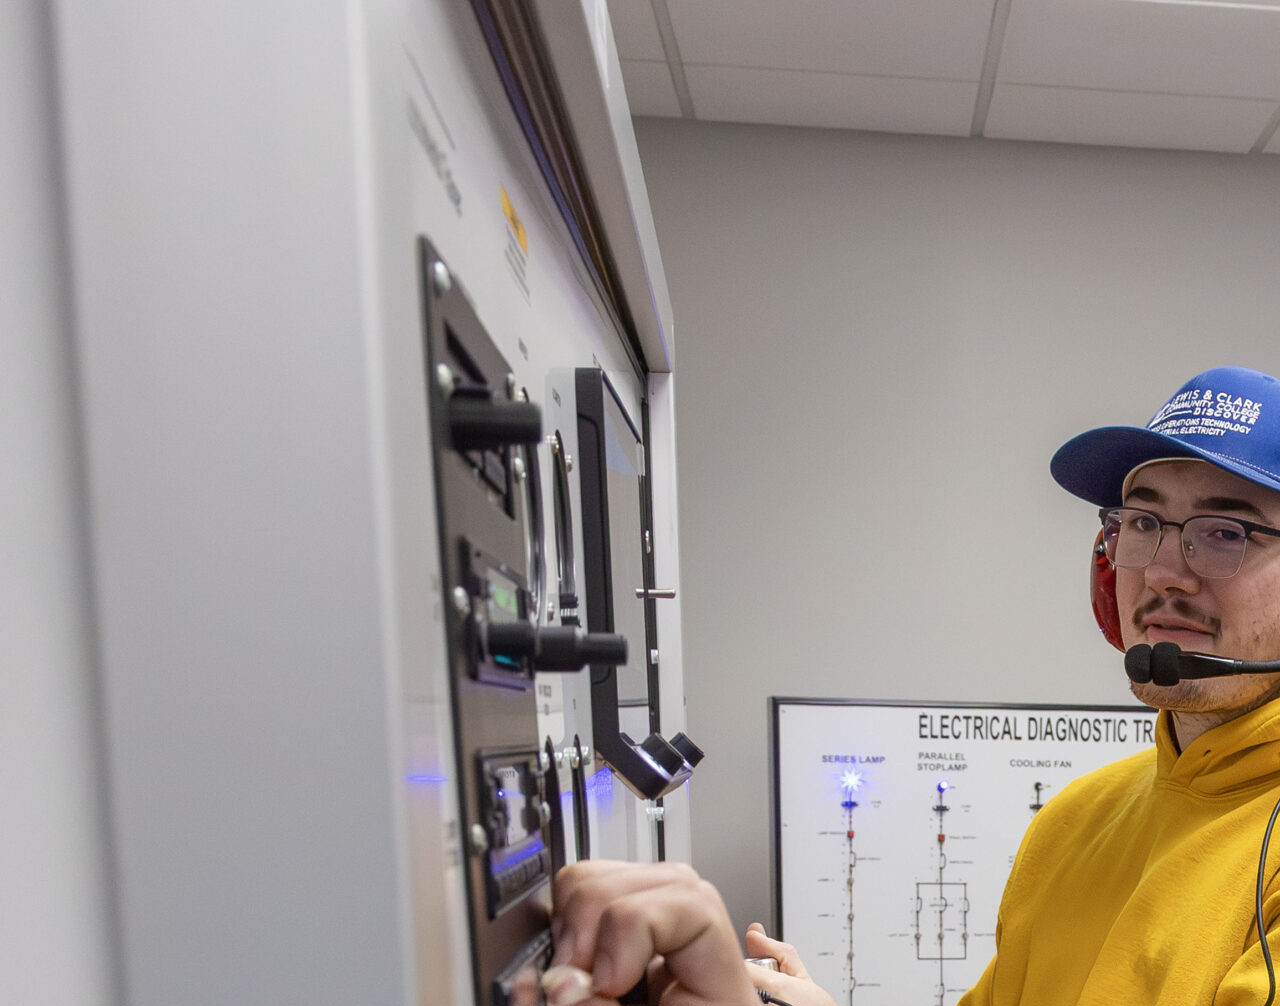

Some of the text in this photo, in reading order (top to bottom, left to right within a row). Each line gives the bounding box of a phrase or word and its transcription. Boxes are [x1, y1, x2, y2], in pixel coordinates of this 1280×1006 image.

[1203, 389, 1213, 401] &
[1216, 392, 1262, 411] CLARK
[1193, 407, 1258, 425] DISCOVER
[1216, 402, 1260, 419] COLLEGE
[1180, 426, 1226, 436] ELECTRICITY
[1200, 418, 1252, 435] TECHNOLOGY
[918, 714, 1022, 741] ELECTRICAL
[1028, 717, 1128, 743] DIAGNOSTIC
[822, 754, 886, 764] SERIES LAMP
[918, 751, 966, 762] PARALLEL
[917, 762, 968, 772] STOPLAMP
[1010, 759, 1073, 769] COOLING FAN
